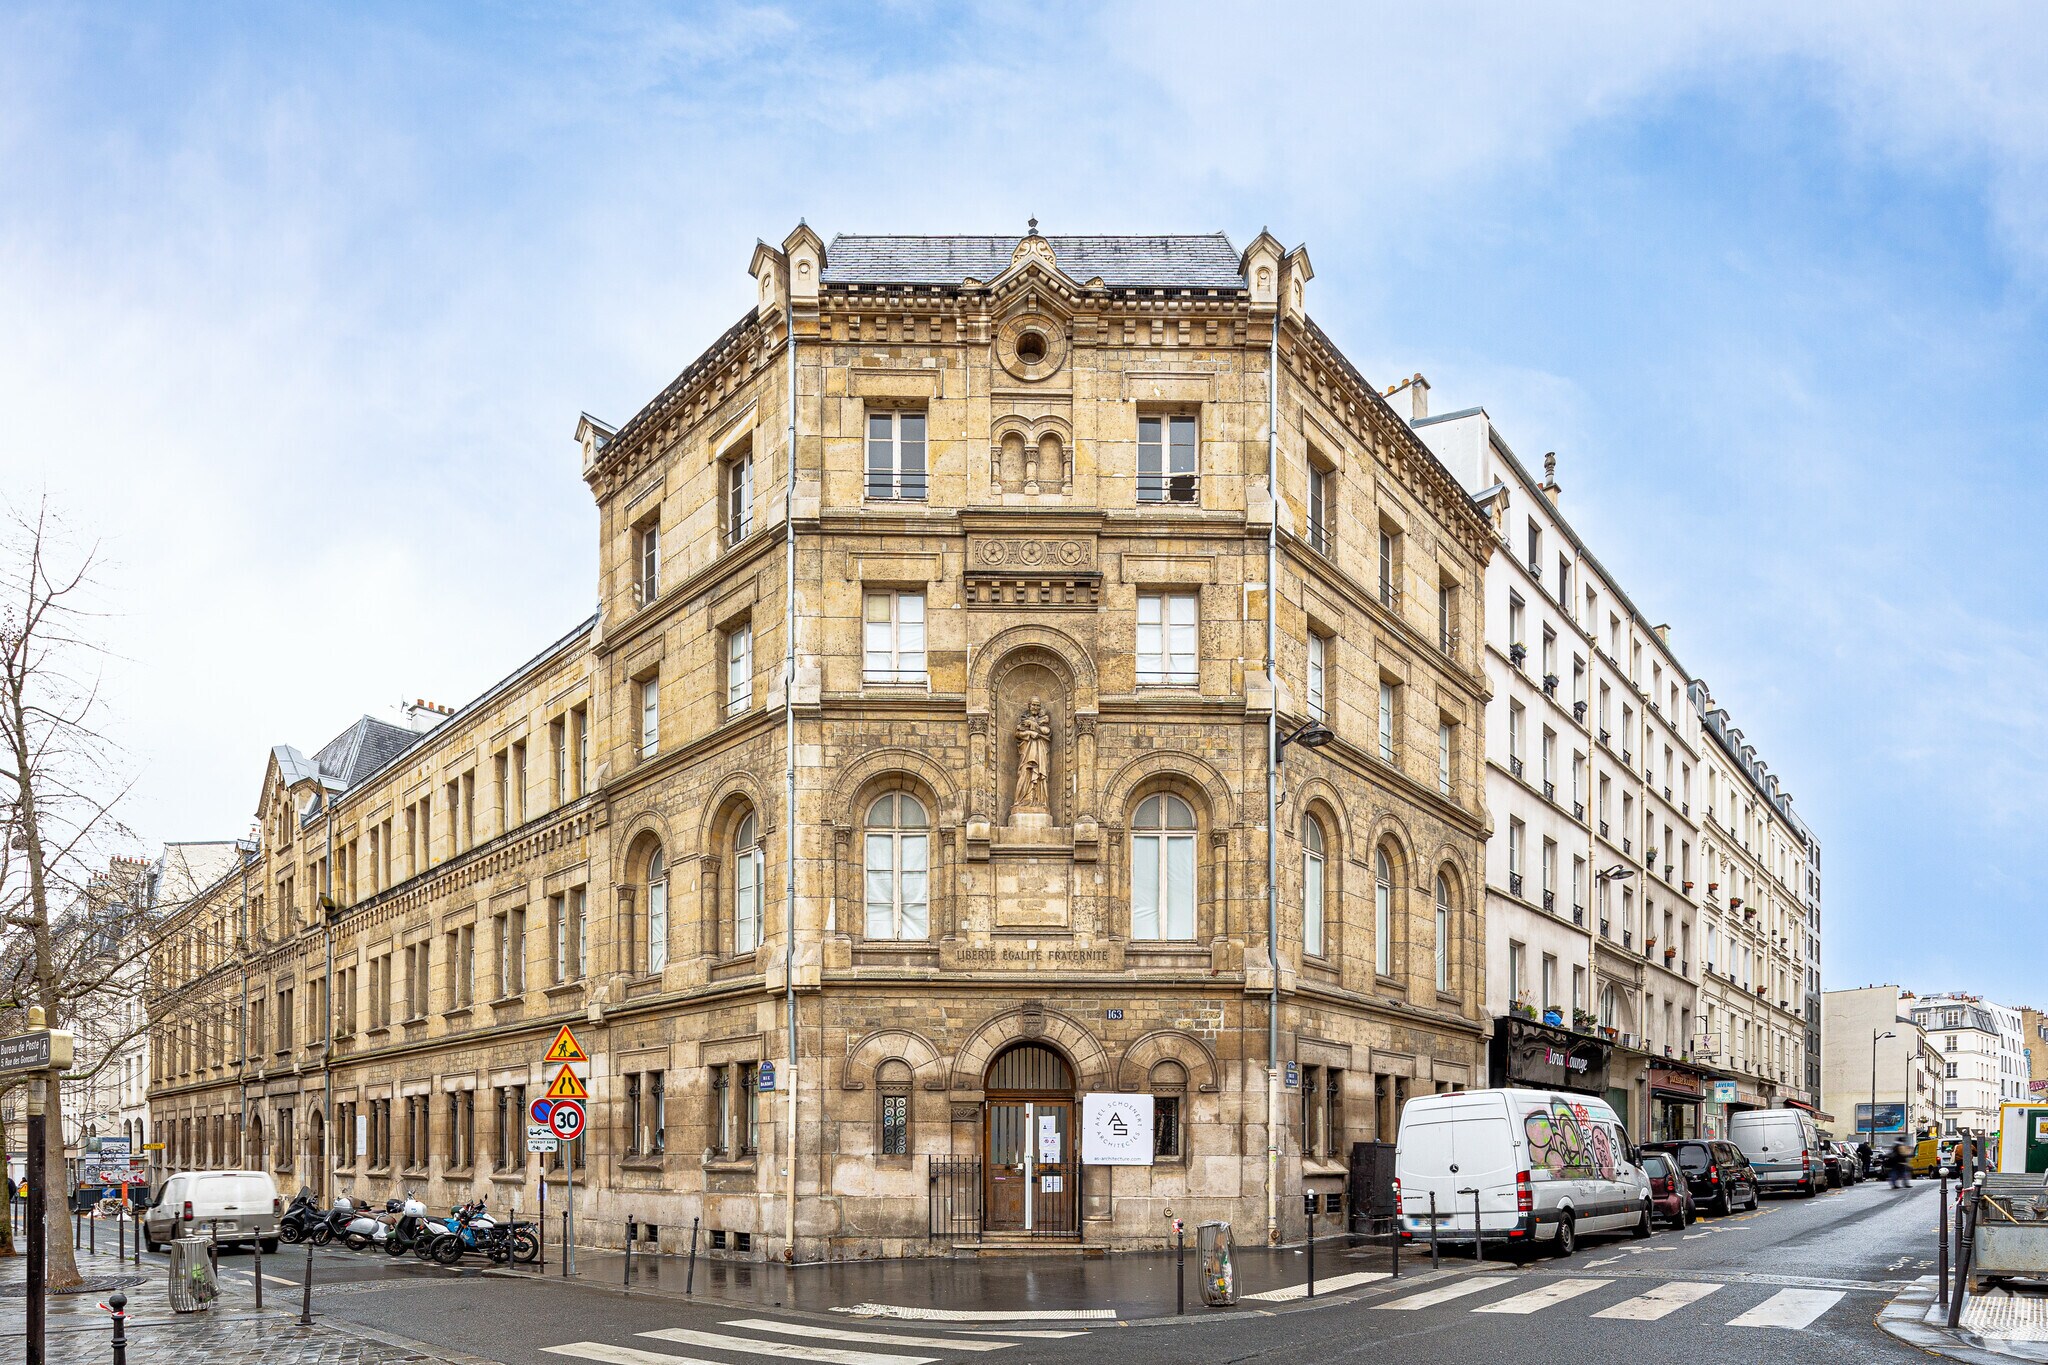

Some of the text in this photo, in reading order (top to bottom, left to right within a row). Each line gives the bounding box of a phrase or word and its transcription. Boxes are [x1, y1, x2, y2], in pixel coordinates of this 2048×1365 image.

[1107, 1009, 1122, 1019] 163
[1, 1040, 39, 1055] Bureau de Poste
[20, 1054, 38, 1064] Goncourt
[1566, 1051, 1588, 1074] Lounge
[556, 1111, 579, 1129] 30
[1095, 1101, 1142, 1126] AXEL SCHOENERT
[1096, 1131, 1141, 1148] ARCHITECTES
